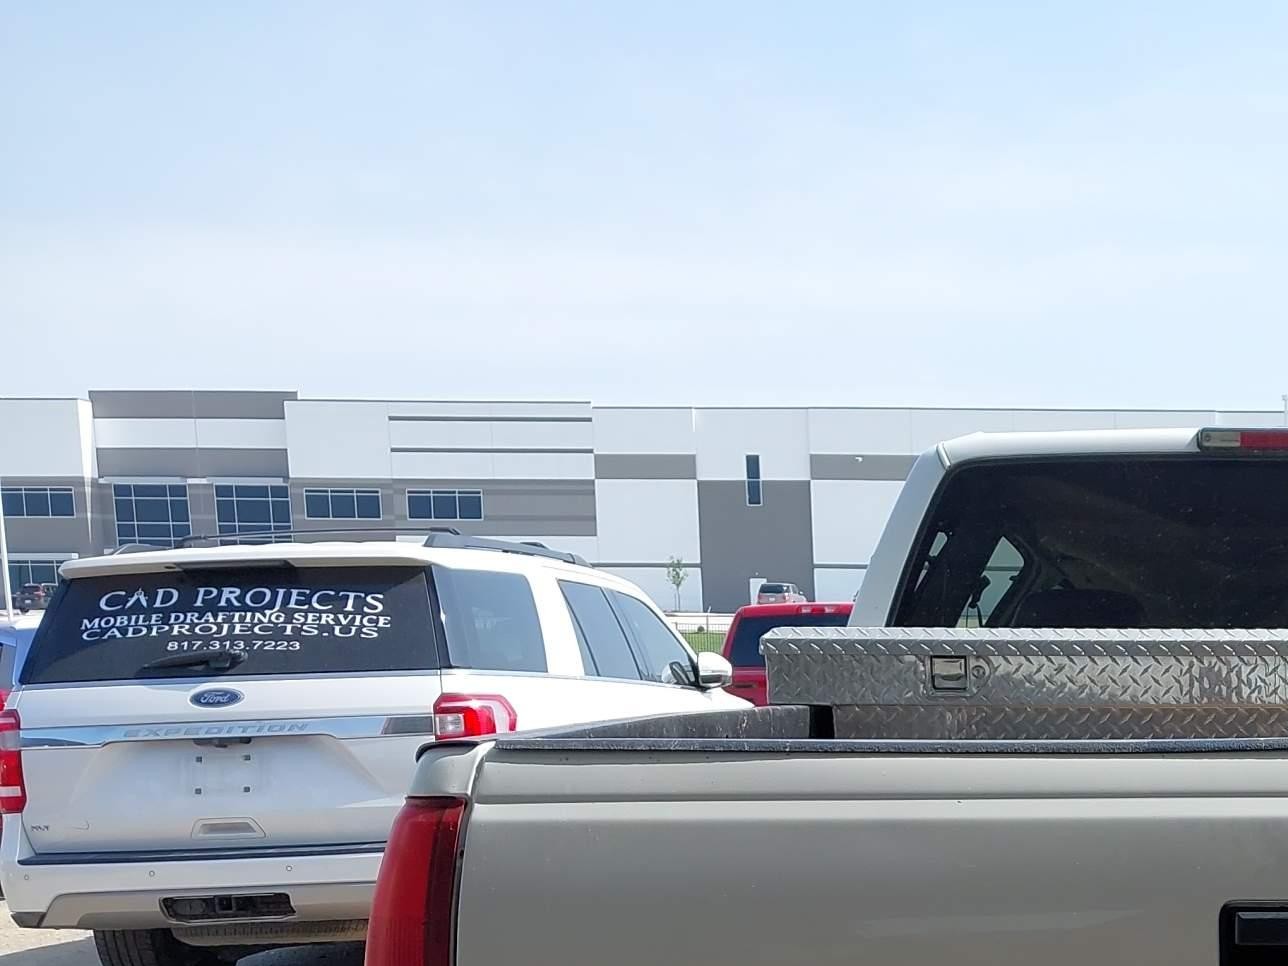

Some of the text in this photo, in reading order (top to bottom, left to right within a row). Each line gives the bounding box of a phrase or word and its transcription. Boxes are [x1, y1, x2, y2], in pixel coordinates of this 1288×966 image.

[99, 586, 385, 614] CAD PROJECTS
[80, 611, 391, 630] MOBILE DRAFTING SERVICE
[81, 623, 380, 641] CADPROJECTS.US
[167, 639, 301, 652] 817.313.7223
[200, 690, 233, 705] Ford
[123, 723, 309, 738] EXPEDITION
